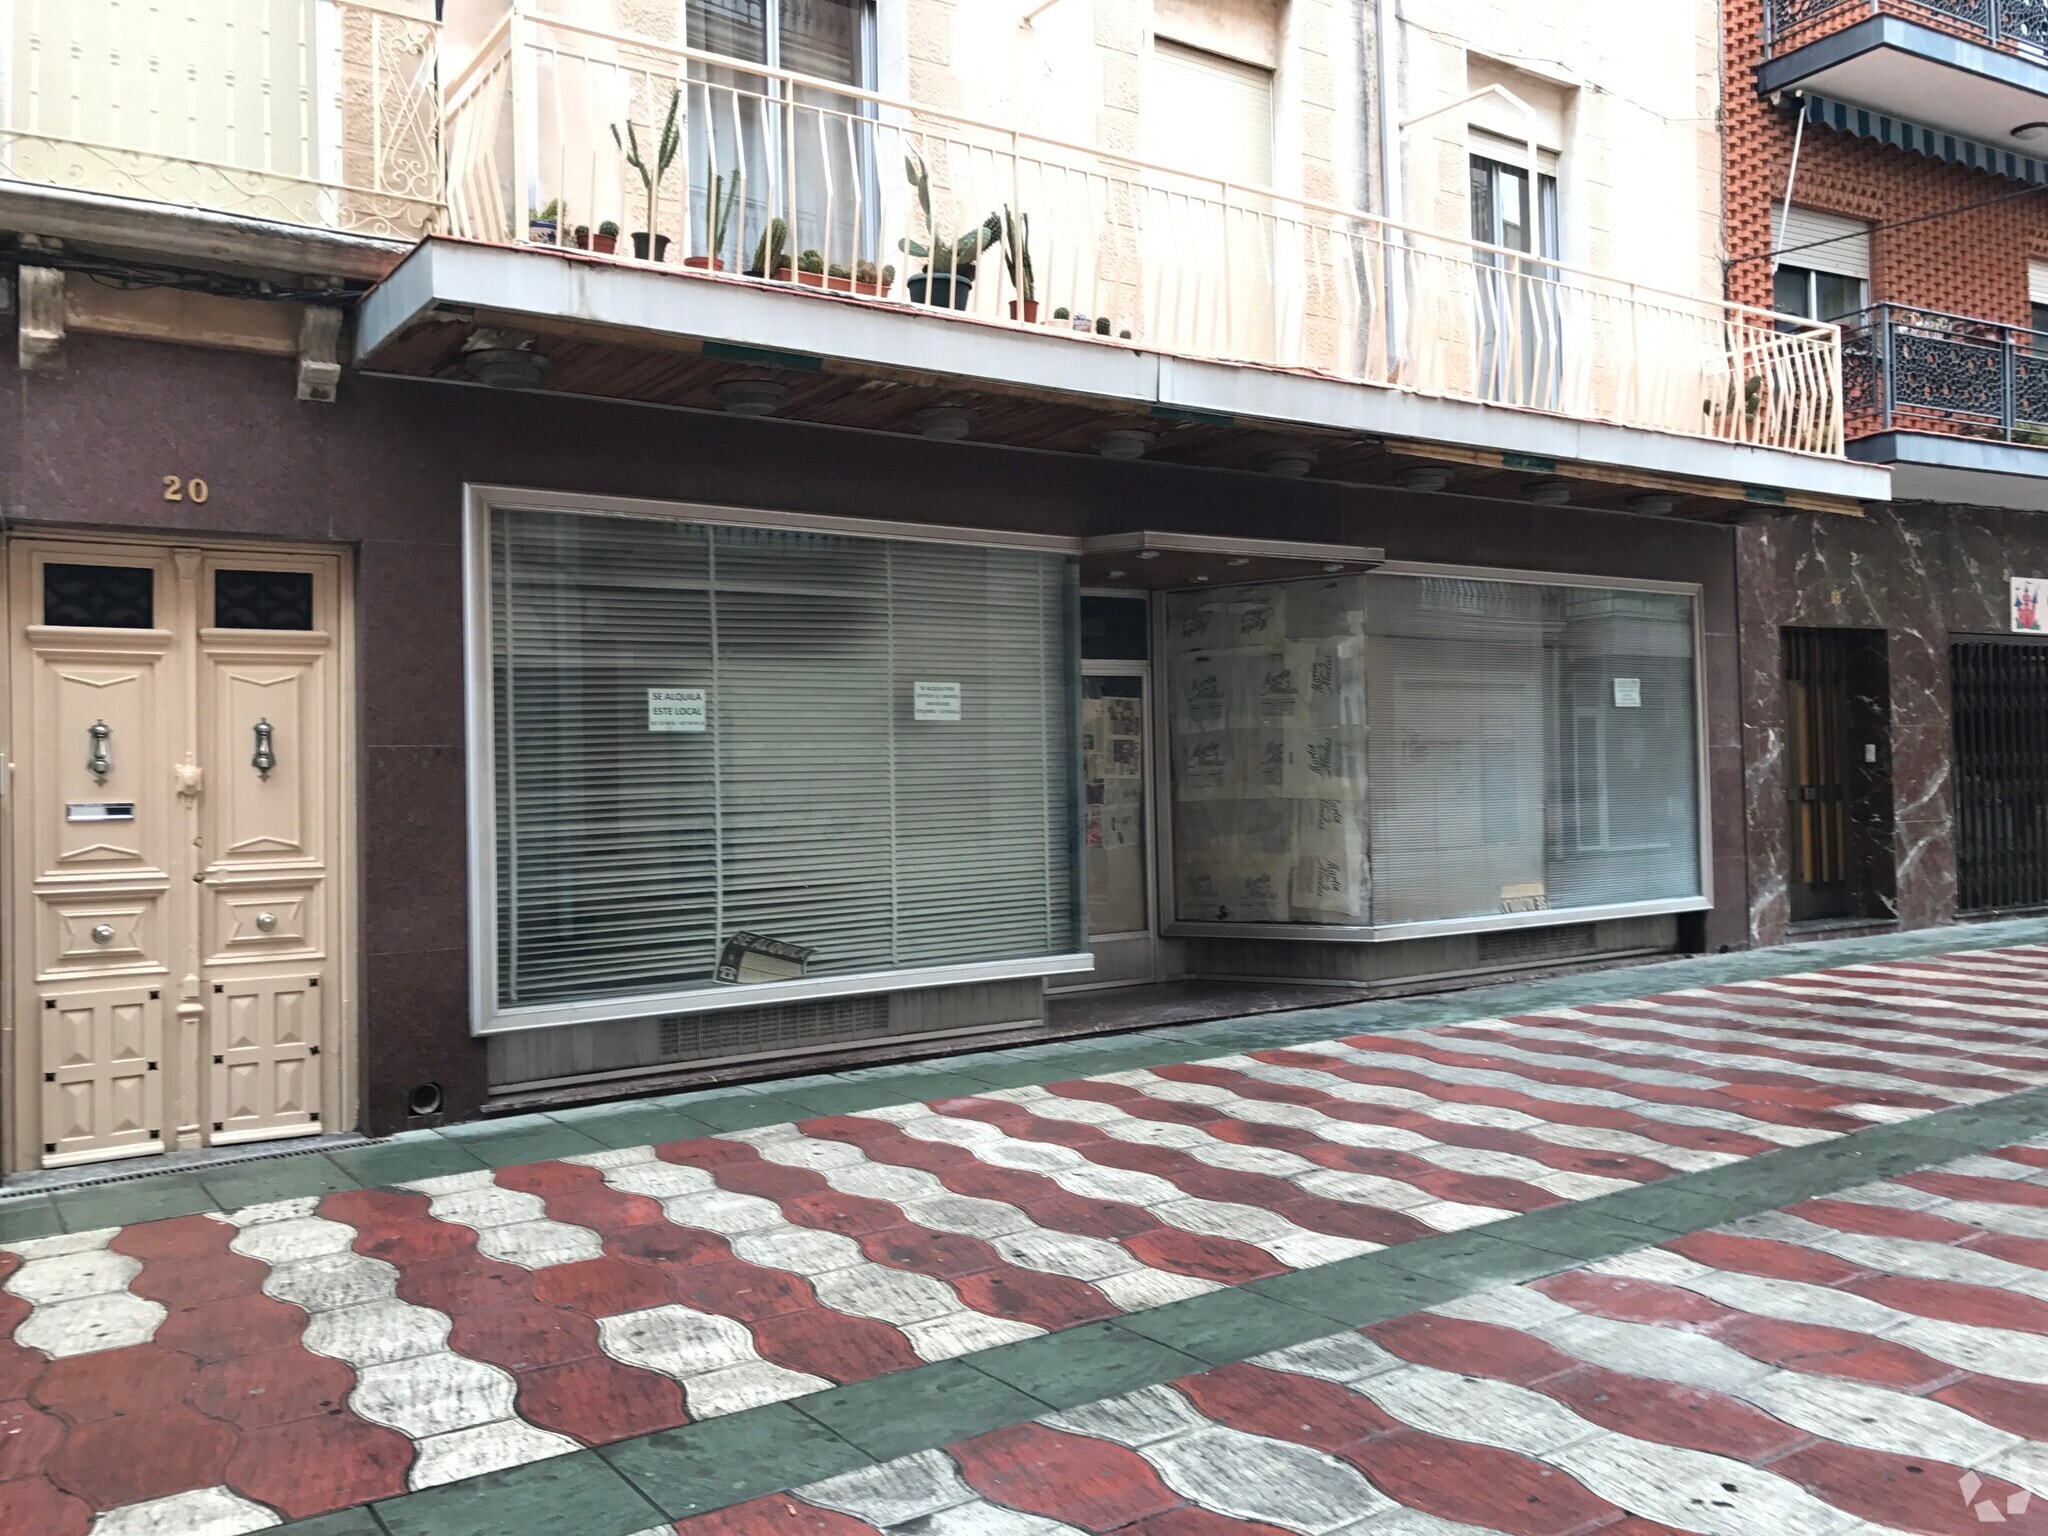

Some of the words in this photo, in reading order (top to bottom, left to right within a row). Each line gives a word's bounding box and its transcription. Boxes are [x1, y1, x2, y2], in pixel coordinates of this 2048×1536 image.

[163, 475, 209, 503] 20
[652, 692, 663, 701] SE
[665, 692, 702, 701] ALQUILA
[653, 707, 673, 716] ESTE
[675, 707, 702, 716] LOCAL
